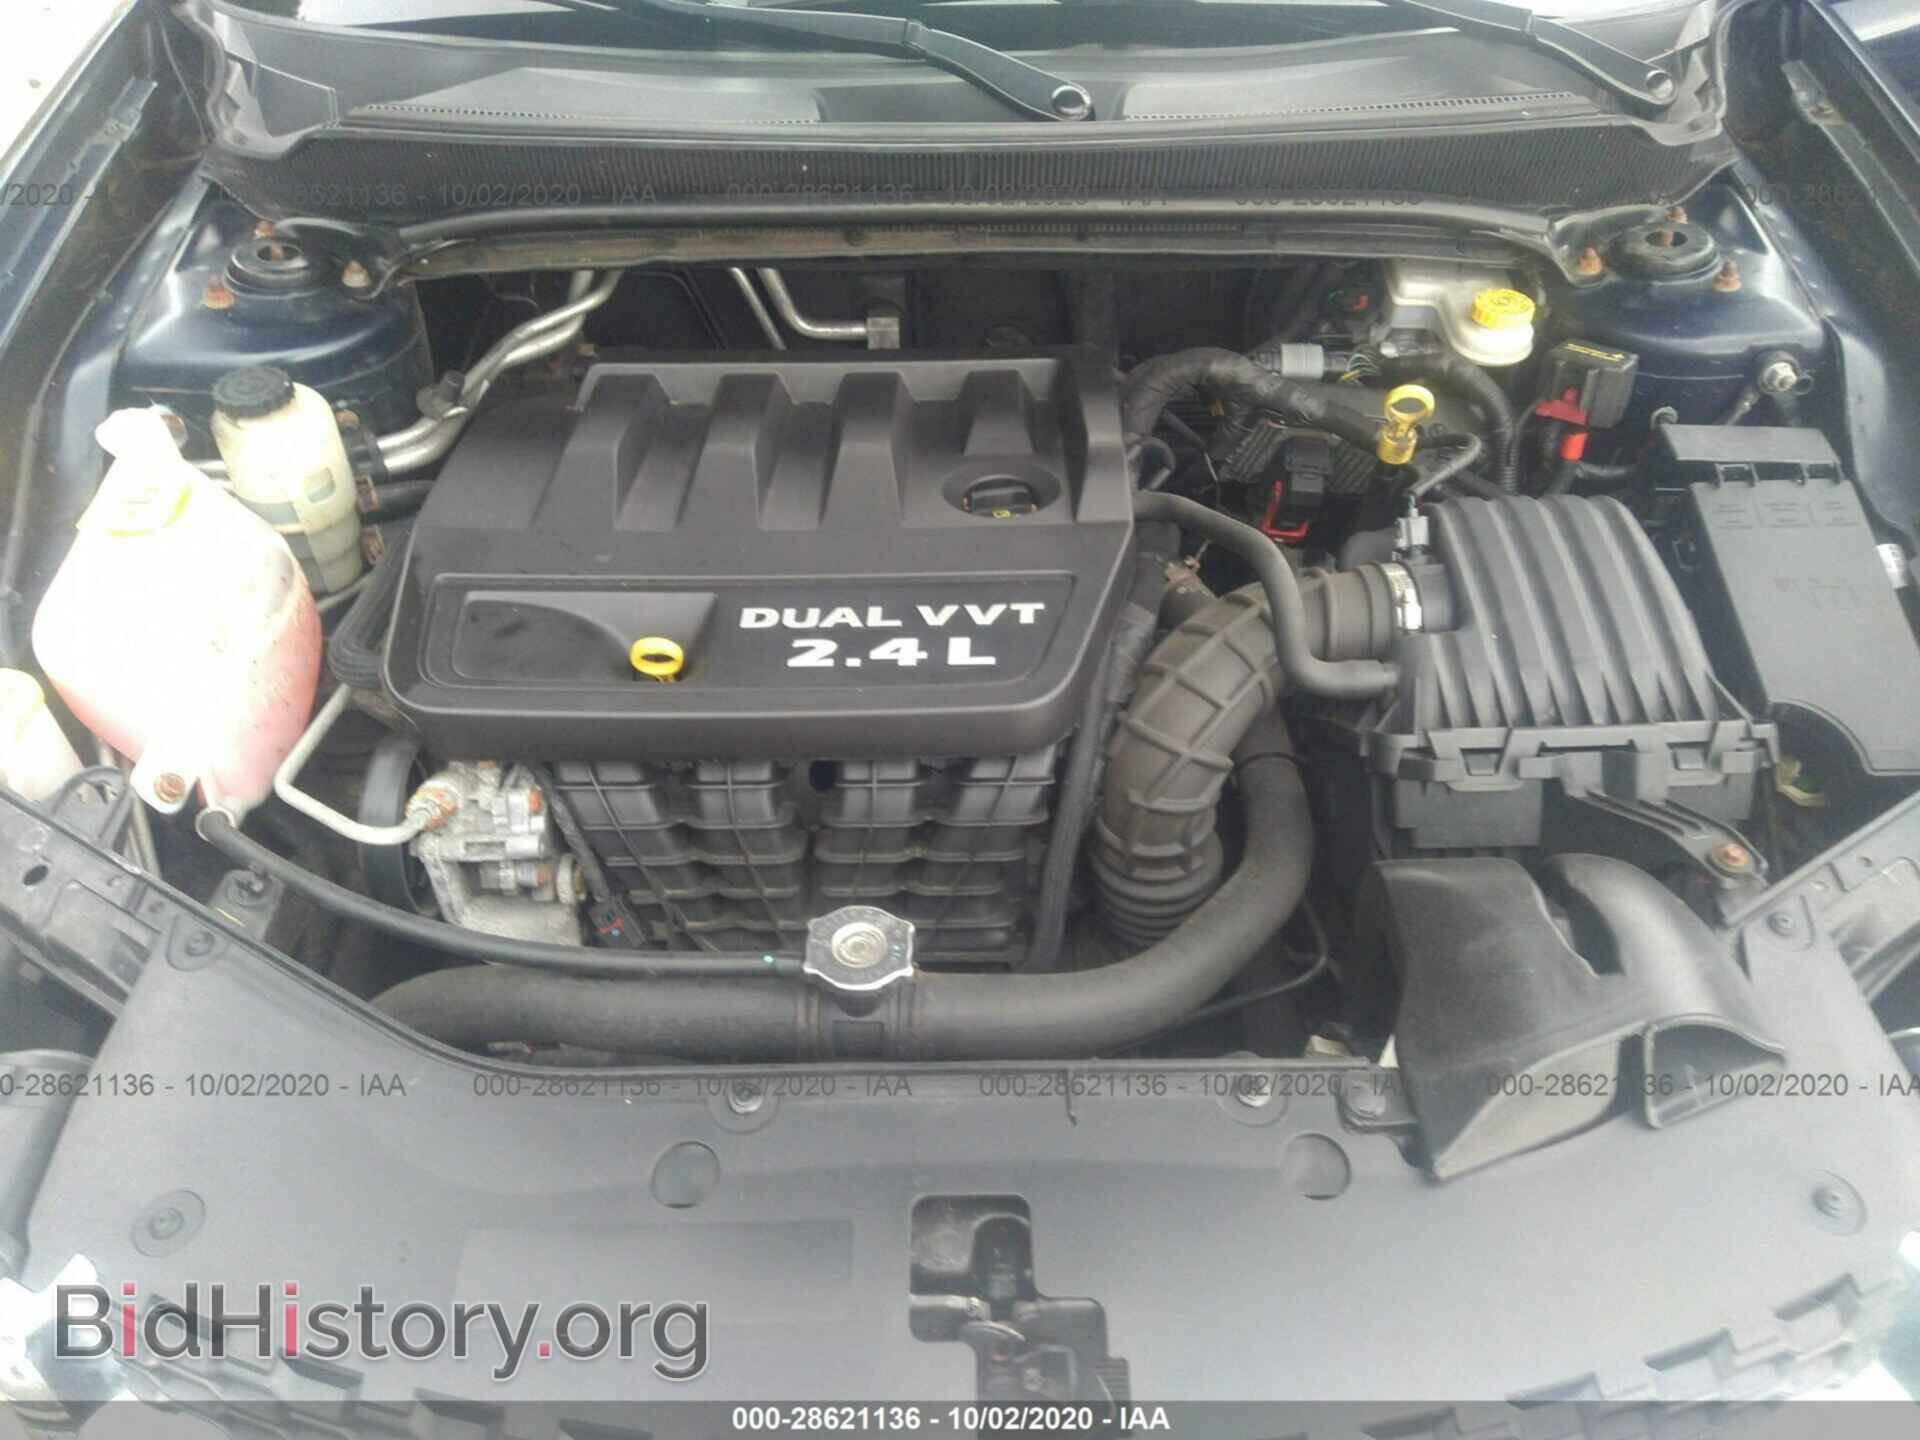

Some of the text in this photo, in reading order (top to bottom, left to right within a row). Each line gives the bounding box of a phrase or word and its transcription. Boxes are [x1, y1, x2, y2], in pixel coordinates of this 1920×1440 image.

[739, 603, 1046, 629] DUAL VVT
[787, 637, 997, 668] 2.4 L
